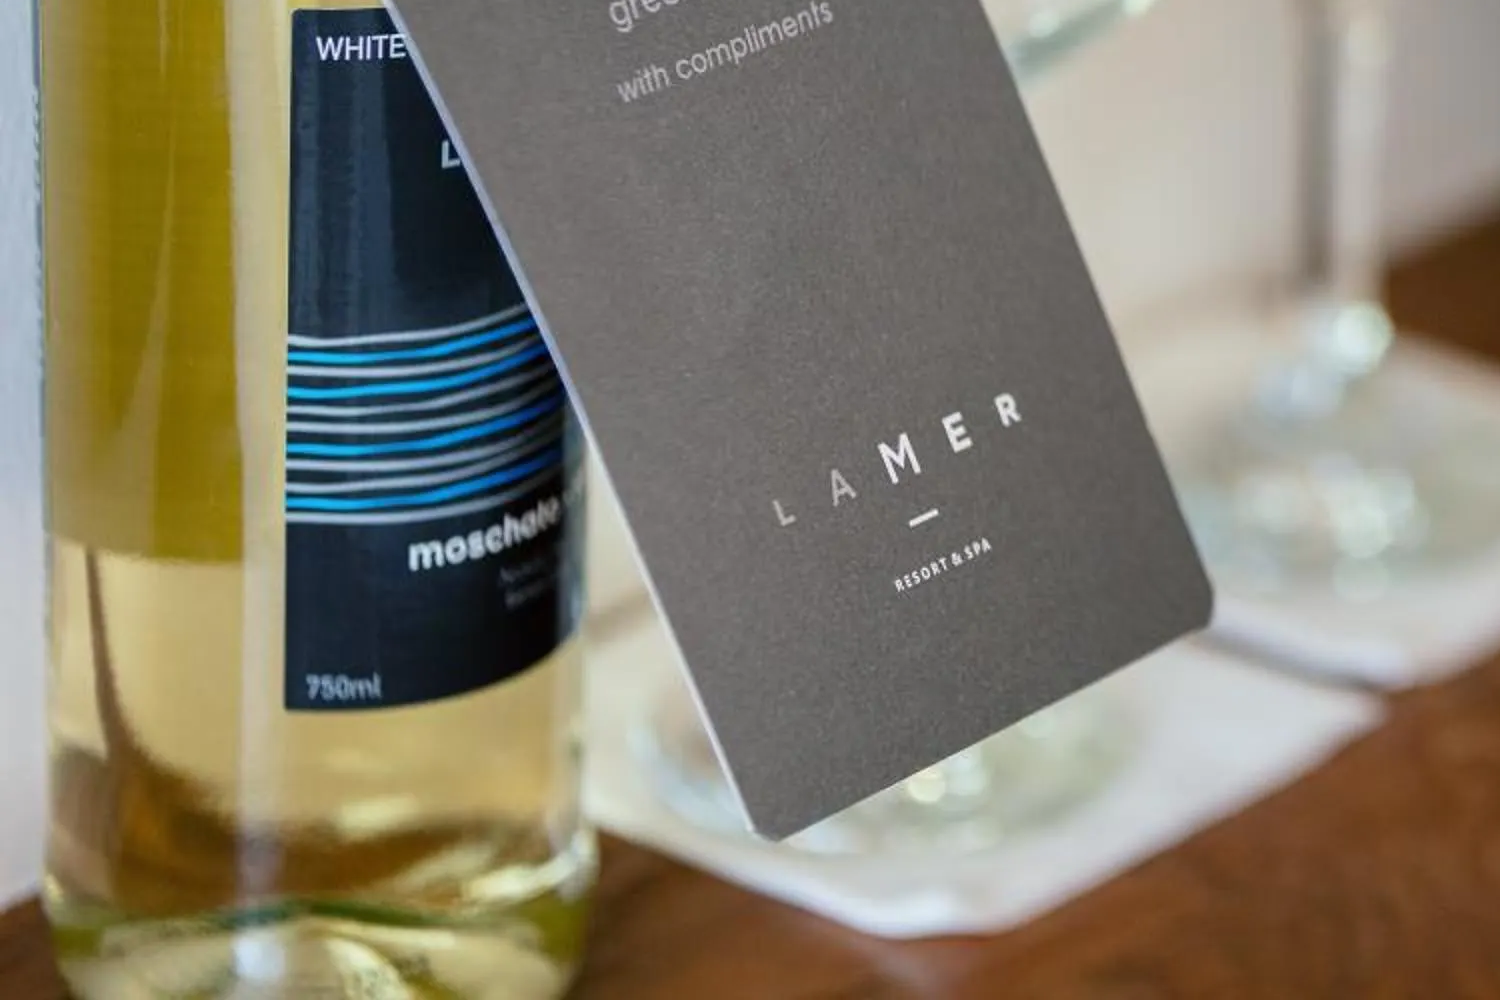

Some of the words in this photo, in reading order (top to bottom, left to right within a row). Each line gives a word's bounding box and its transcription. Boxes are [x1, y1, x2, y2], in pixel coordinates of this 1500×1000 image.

[315, 33, 407, 61] WHITE
[616, 64, 671, 102] with
[675, 0, 834, 79] compliments
[894, 556, 949, 593] RESORT
[950, 551, 964, 567] &
[963, 536, 993, 561] SPA
[305, 671, 382, 701] 750ml
